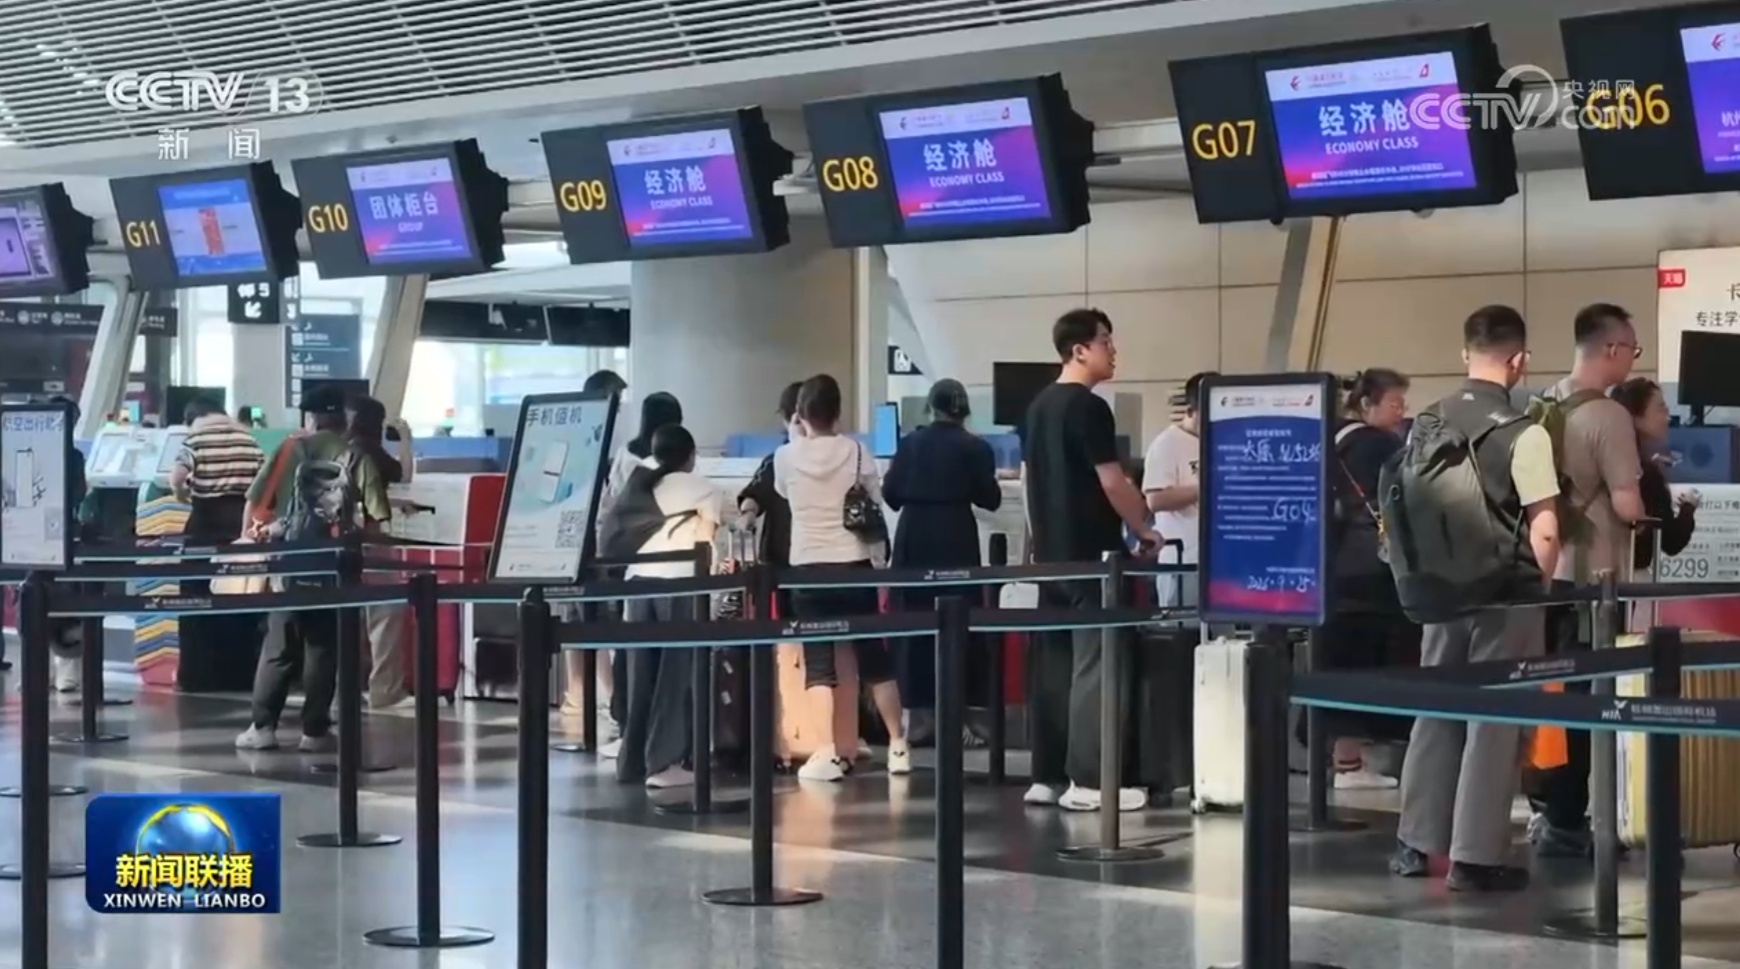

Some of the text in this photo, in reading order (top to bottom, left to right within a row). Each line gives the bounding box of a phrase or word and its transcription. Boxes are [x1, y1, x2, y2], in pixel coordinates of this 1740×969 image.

[1318, 98, 1410, 137] 经济舱
[1586, 83, 1670, 129] G06
[1192, 120, 1256, 160] G07
[1325, 136, 1419, 155] ECONOMY CLASS
[923, 138, 997, 172] 经济舱
[644, 165, 707, 195] 经济舱
[822, 157, 878, 192] G08
[929, 171, 1005, 188] ECONOMY CLASS
[369, 191, 438, 219] 团体柜台
[559, 180, 607, 213] G09
[308, 204, 348, 233] G10
[126, 220, 160, 247] G11
[1696, 311, 1740, 327] 专注学
[527, 406, 583, 426] 手机值机
[1660, 558, 1709, 578] 6299
